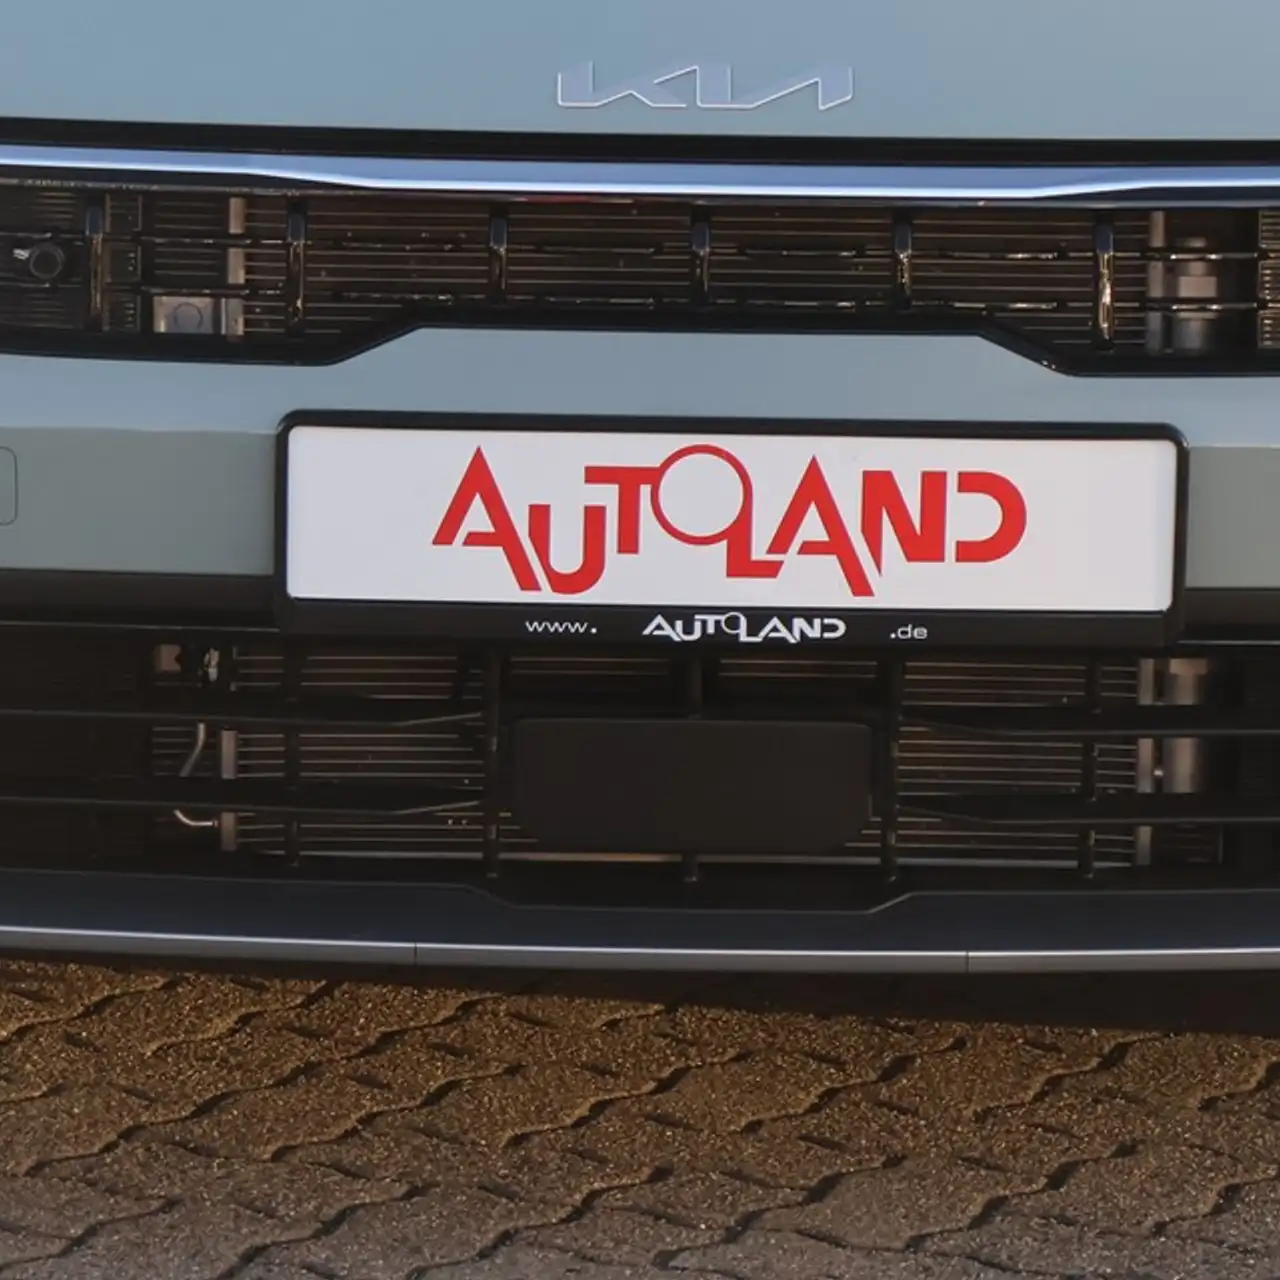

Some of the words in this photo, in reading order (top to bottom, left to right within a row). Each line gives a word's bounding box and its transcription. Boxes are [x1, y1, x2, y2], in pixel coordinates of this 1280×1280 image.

[558, 61, 853, 111] KIA
[432, 444, 1027, 597] AUTOLAND
[525, 620, 597, 635] www.
[642, 611, 847, 644] AUTOLAND
[889, 623, 929, 640] .de
